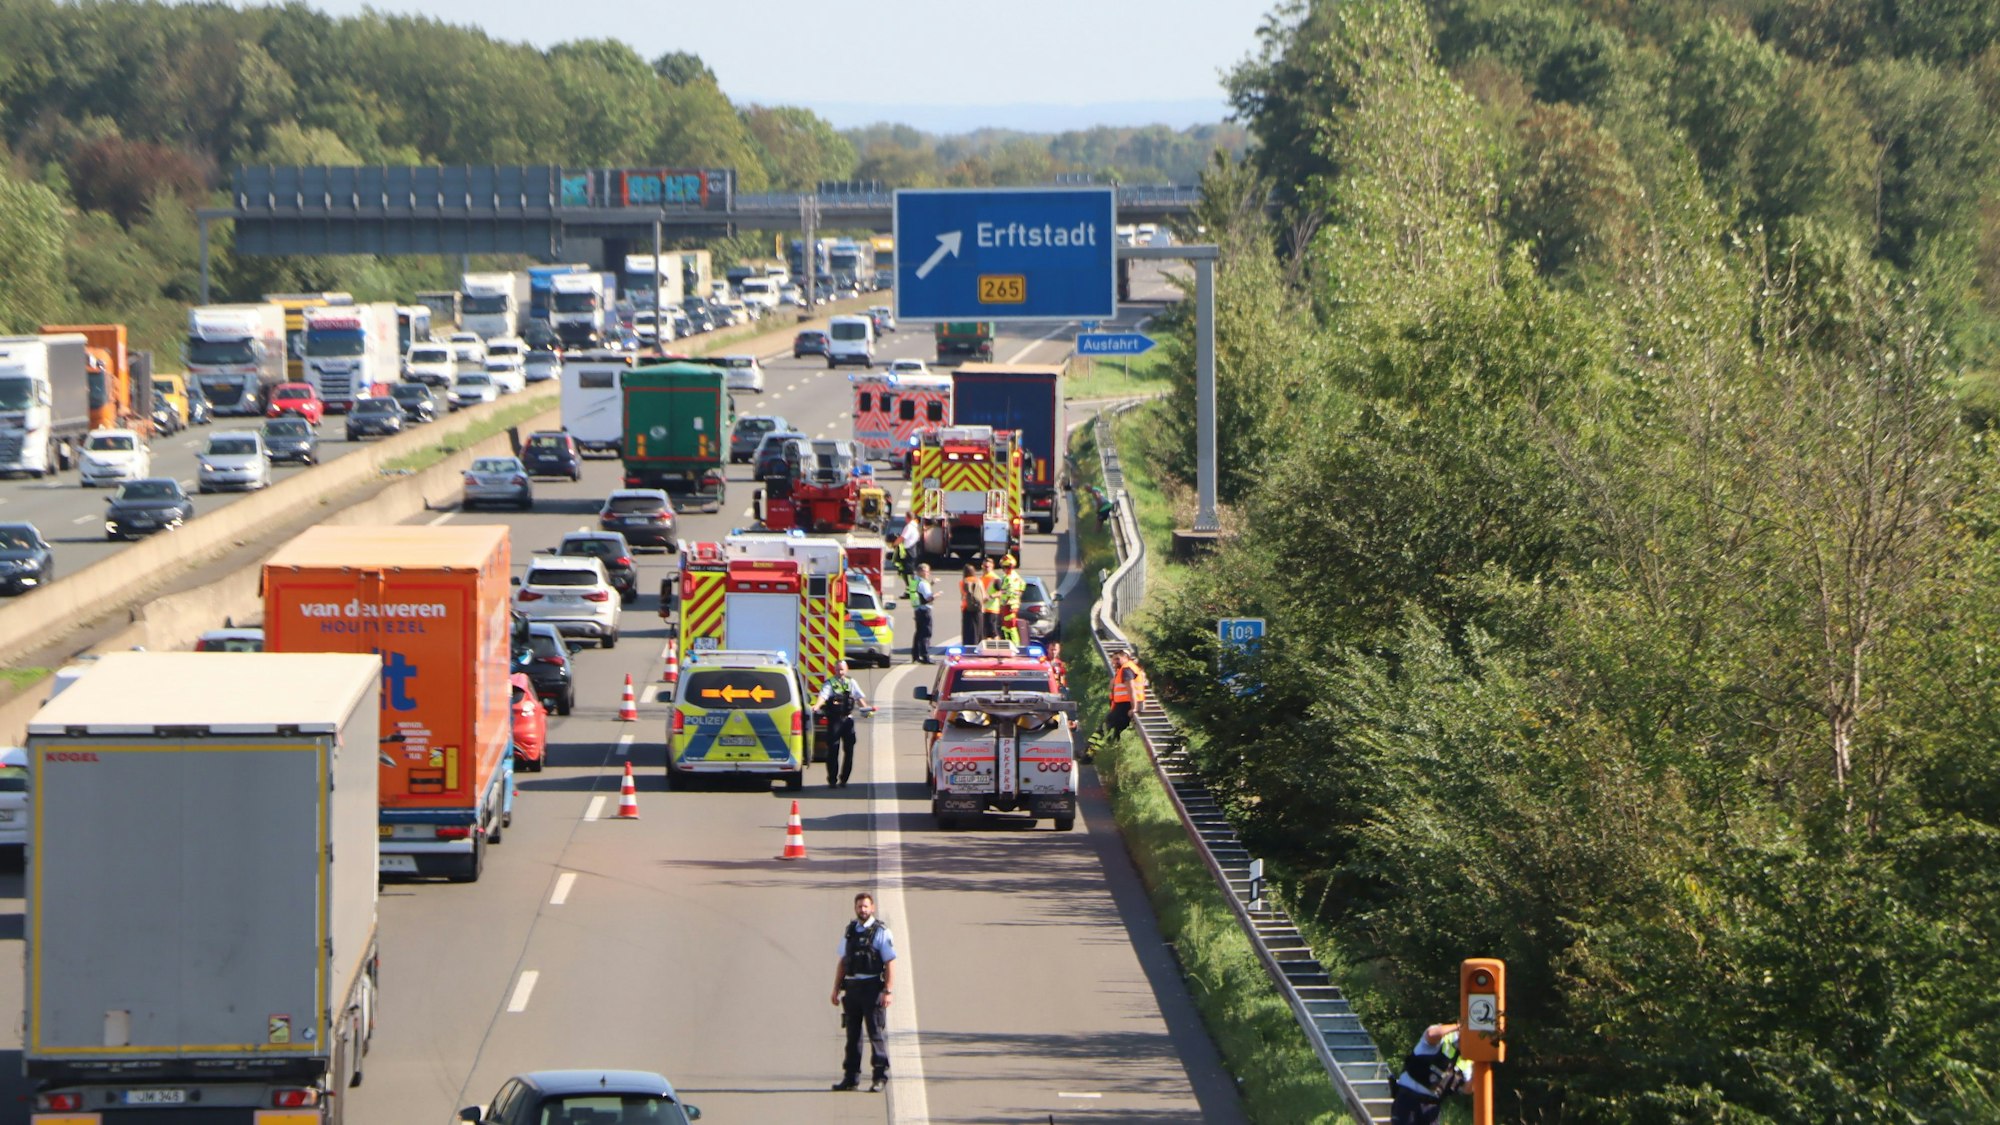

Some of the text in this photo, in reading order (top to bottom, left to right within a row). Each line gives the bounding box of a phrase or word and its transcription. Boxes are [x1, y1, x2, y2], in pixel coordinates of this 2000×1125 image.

[977, 222, 1096, 247] Erftstadt
[984, 281, 1019, 298] 265
[1083, 338, 1139, 351] Ausfahrt
[300, 602, 340, 617] van
[684, 716, 724, 725] POLIZEI
